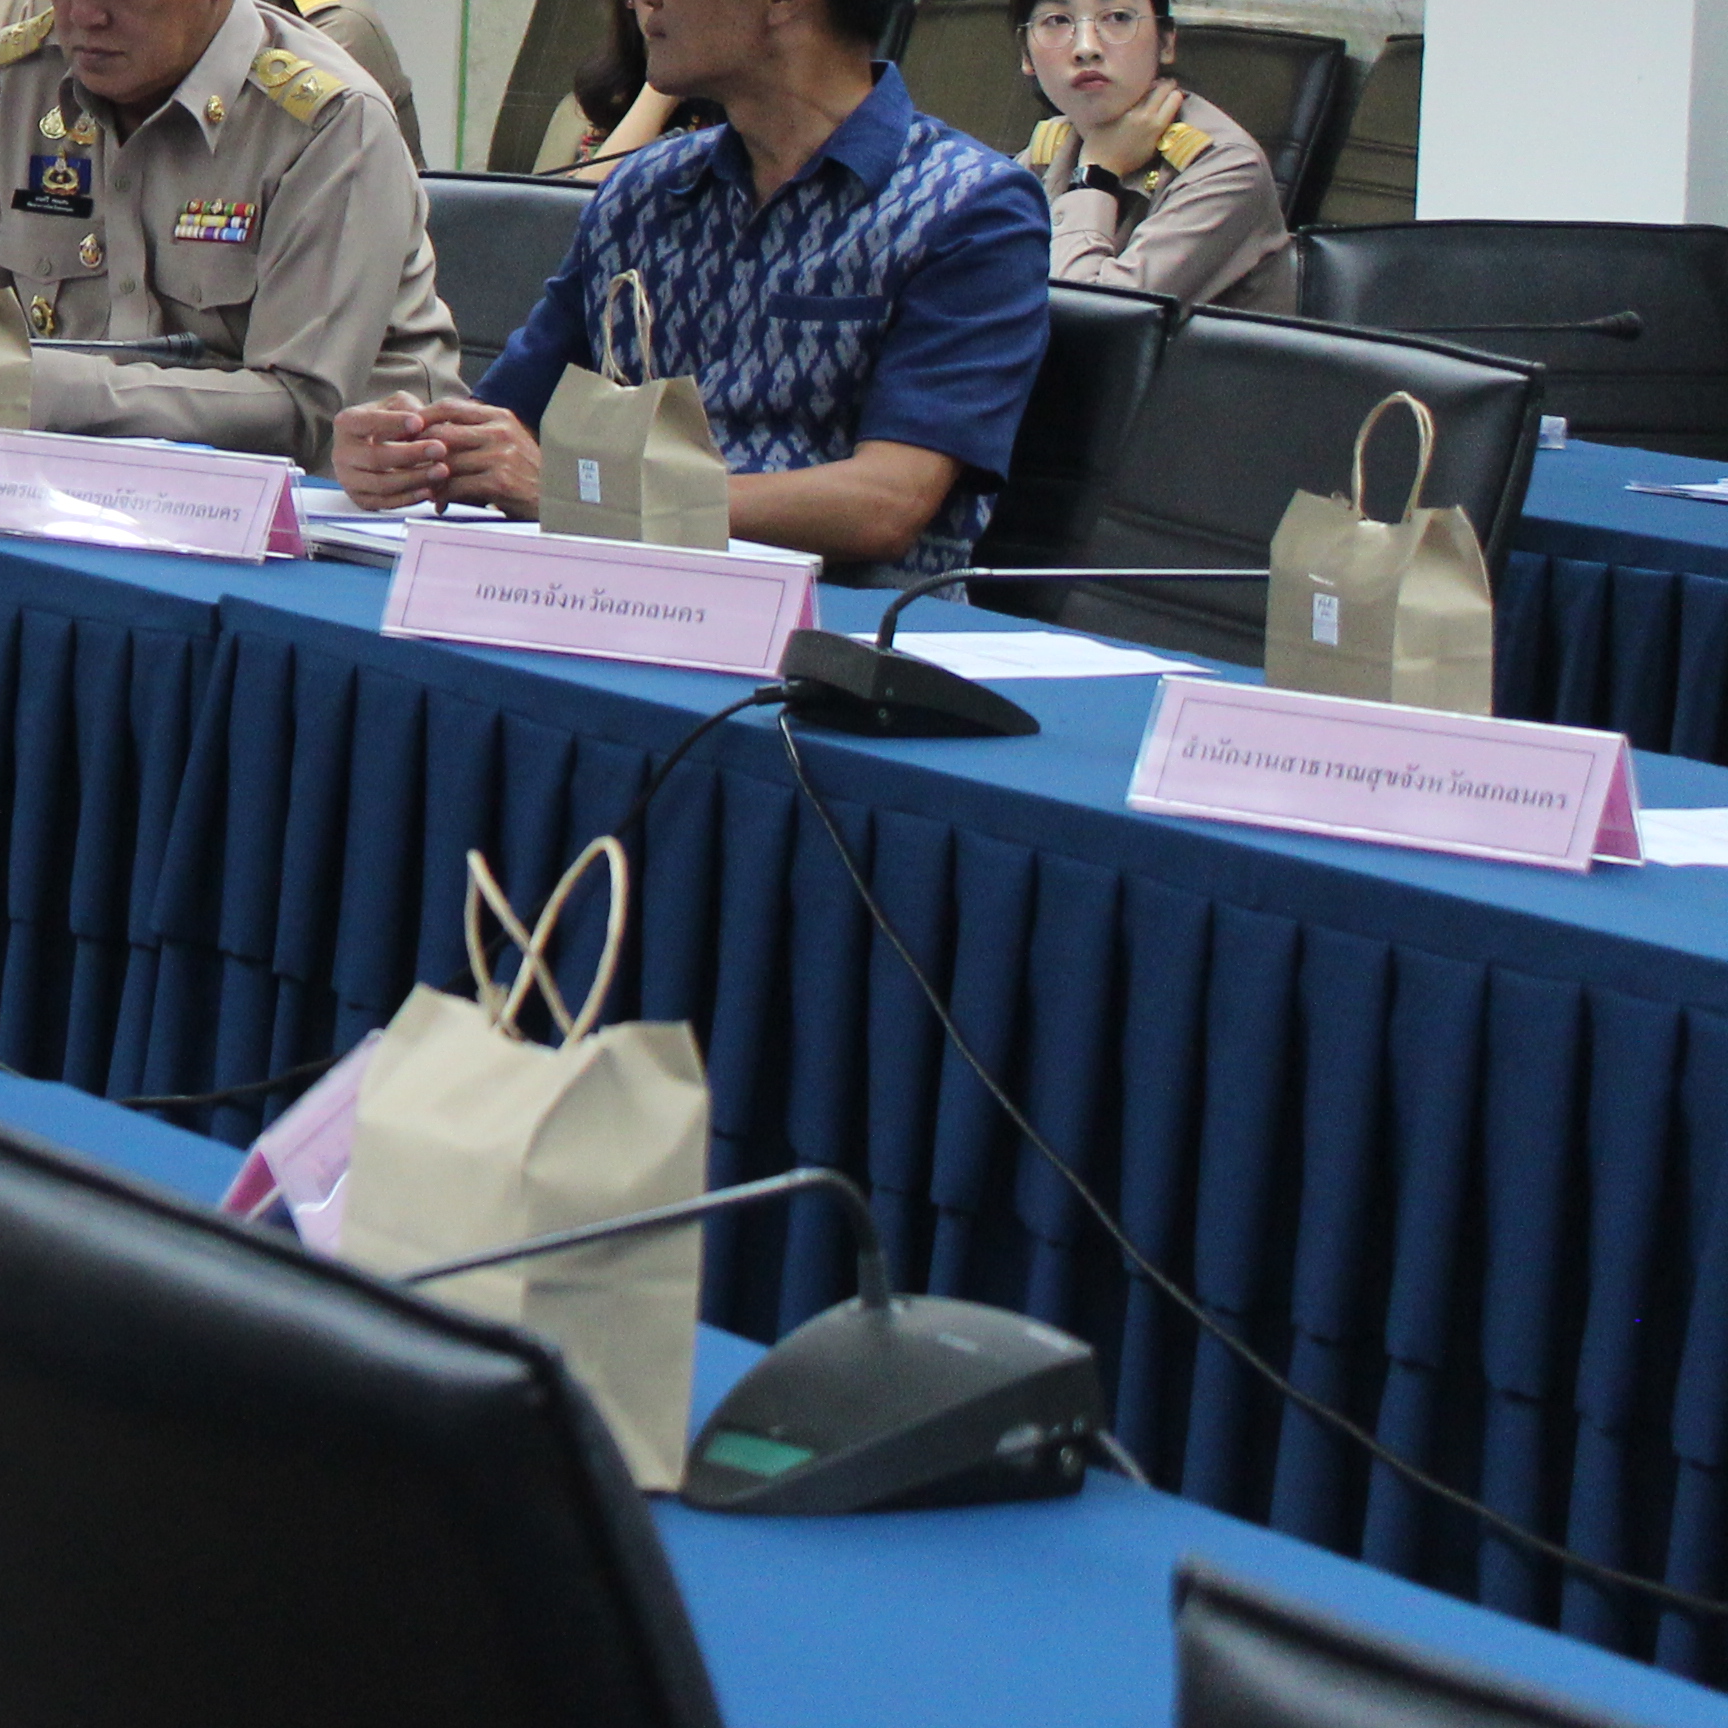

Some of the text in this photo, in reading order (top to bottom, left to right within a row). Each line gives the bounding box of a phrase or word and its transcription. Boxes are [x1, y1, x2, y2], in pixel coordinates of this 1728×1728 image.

[475, 582, 707, 623] เกษตรจังหวัดสกลนคร
[1181, 734, 1568, 810] สำนักงานสาธารณสุขจังหวัดสกลนคร
